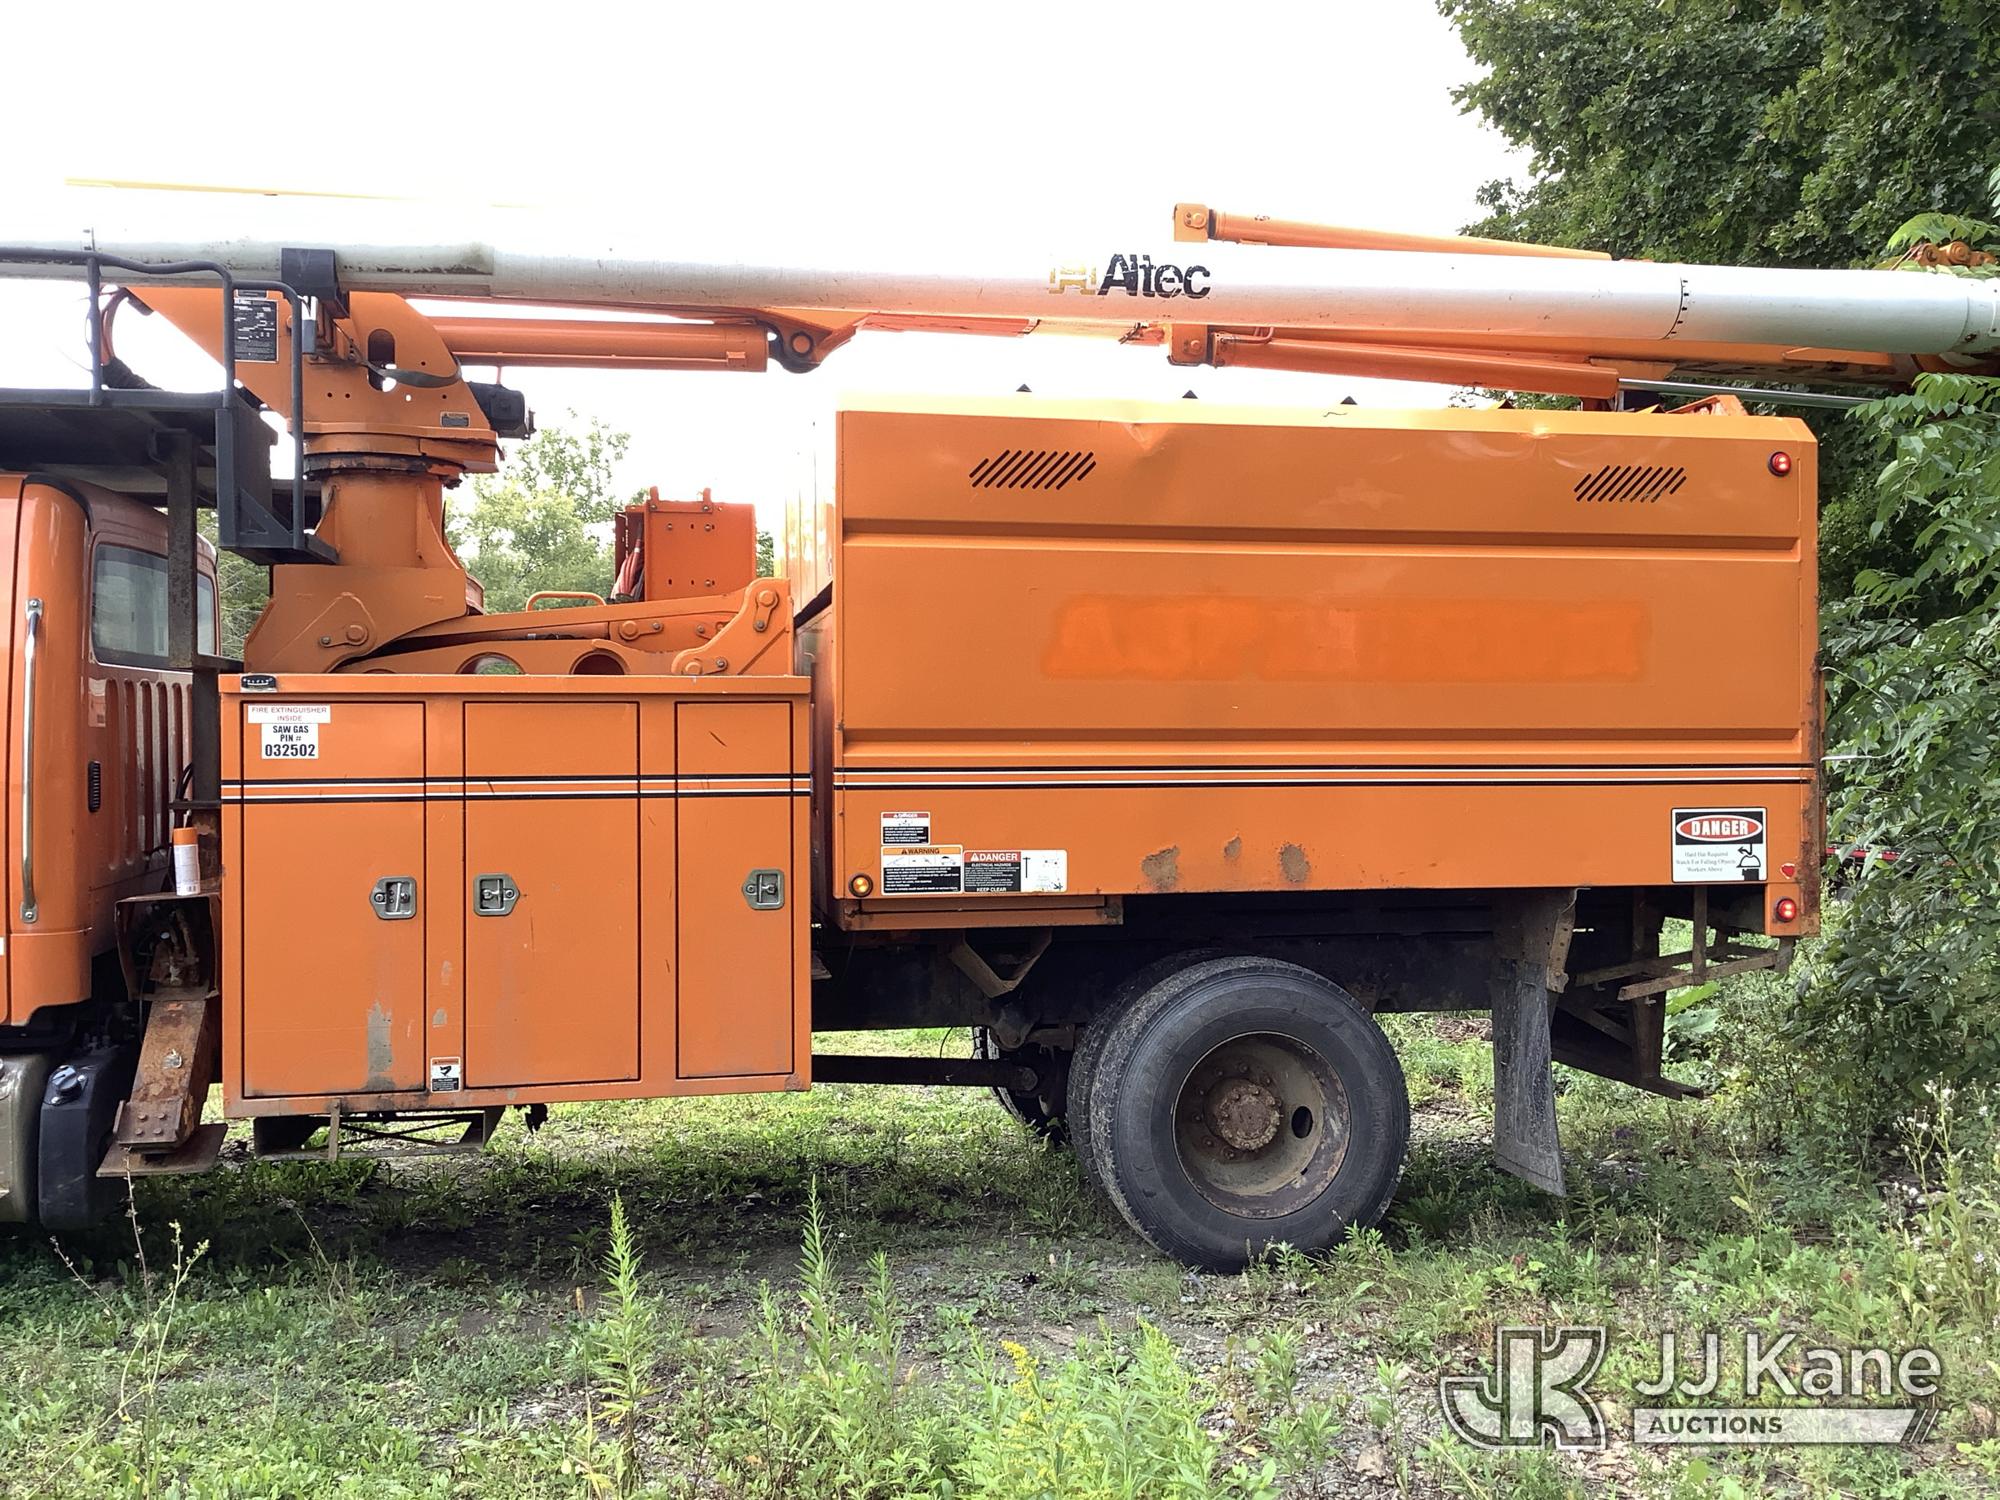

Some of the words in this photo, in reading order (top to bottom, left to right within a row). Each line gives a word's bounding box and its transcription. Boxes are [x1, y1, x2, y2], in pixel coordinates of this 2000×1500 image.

[1097, 253, 1211, 299] Altec
[272, 725, 291, 734] SAW
[293, 725, 309, 734] GAS
[280, 734, 293, 742] PIN
[265, 743, 316, 757] 032502
[1691, 820, 1749, 836] DANGER
[979, 853, 1018, 861] DANGER
